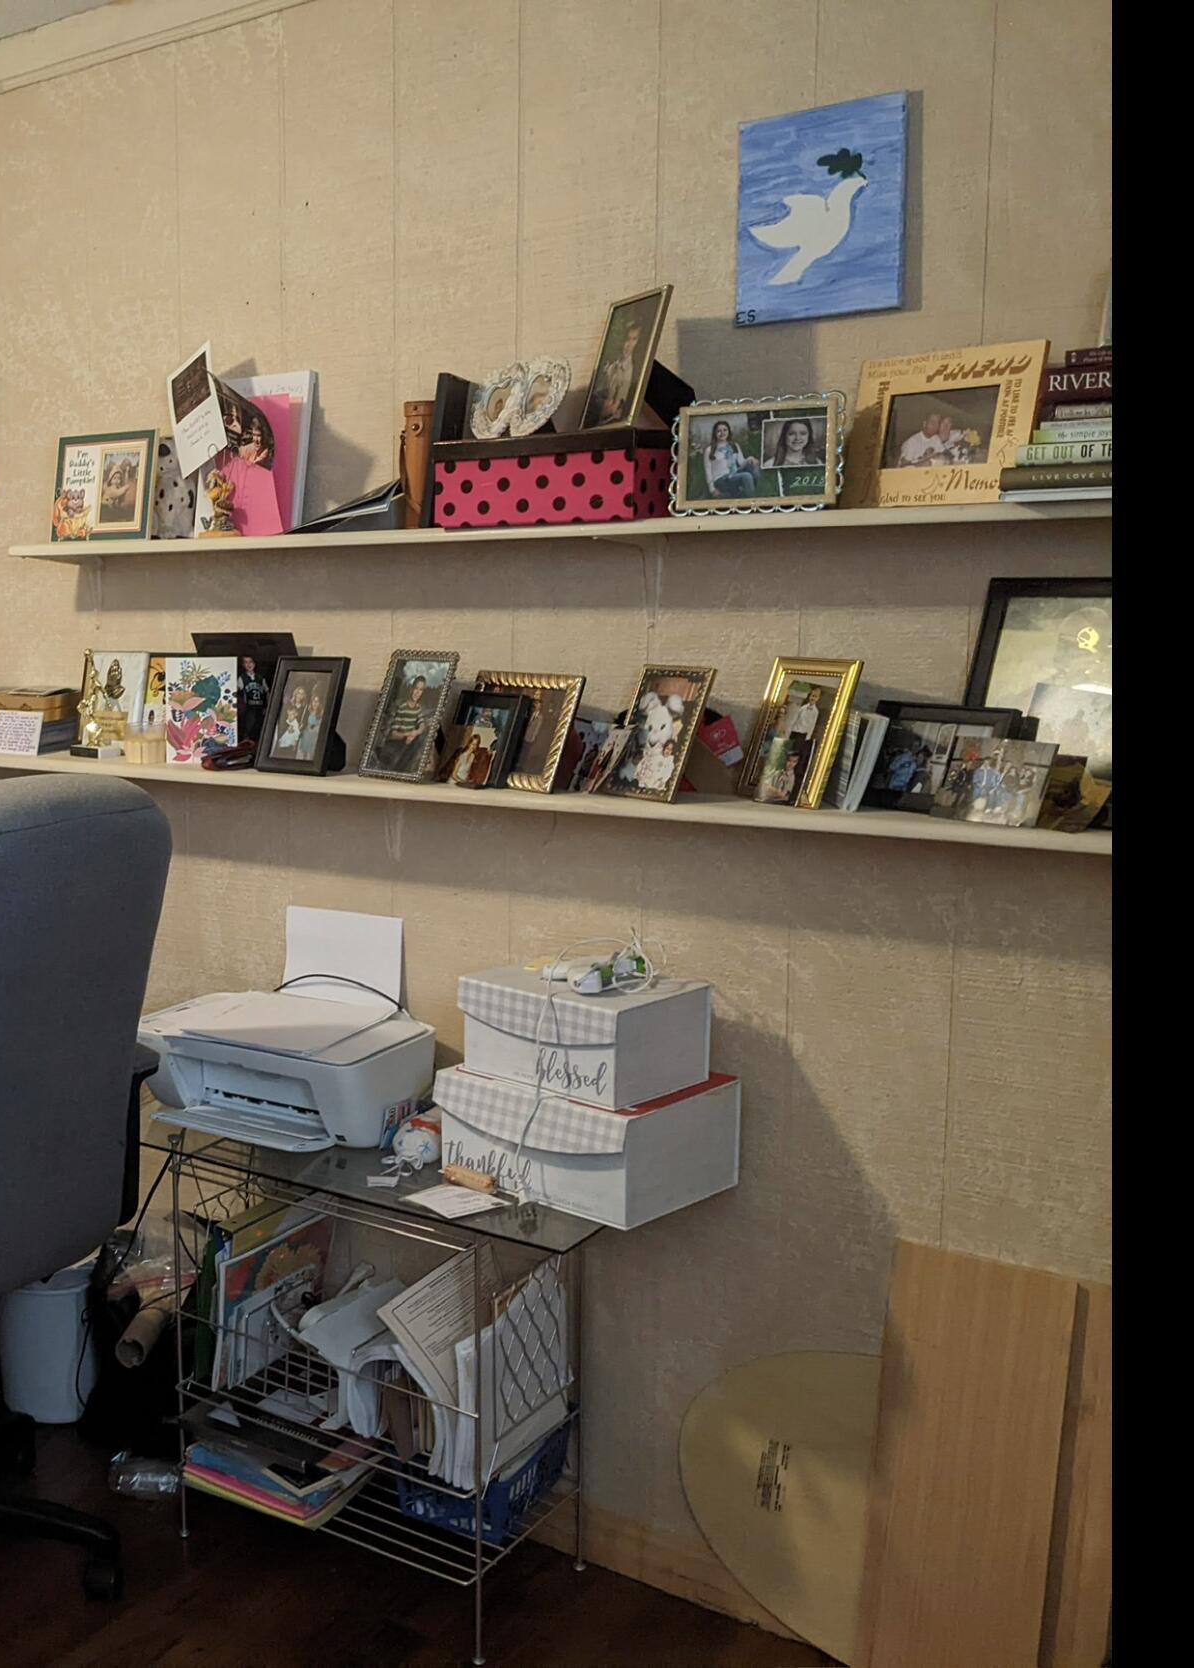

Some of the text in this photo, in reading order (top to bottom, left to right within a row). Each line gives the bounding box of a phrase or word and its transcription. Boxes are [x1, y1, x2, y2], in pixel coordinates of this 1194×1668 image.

[736, 309, 756, 325] ES
[1048, 371, 1112, 392] RIVER
[1027, 446, 1046, 460] GET
[1053, 445, 1075, 459] OUT
[1081, 444, 1095, 458] OF
[73, 469, 91, 477] Little
[536, 1047, 608, 1096] blessed
